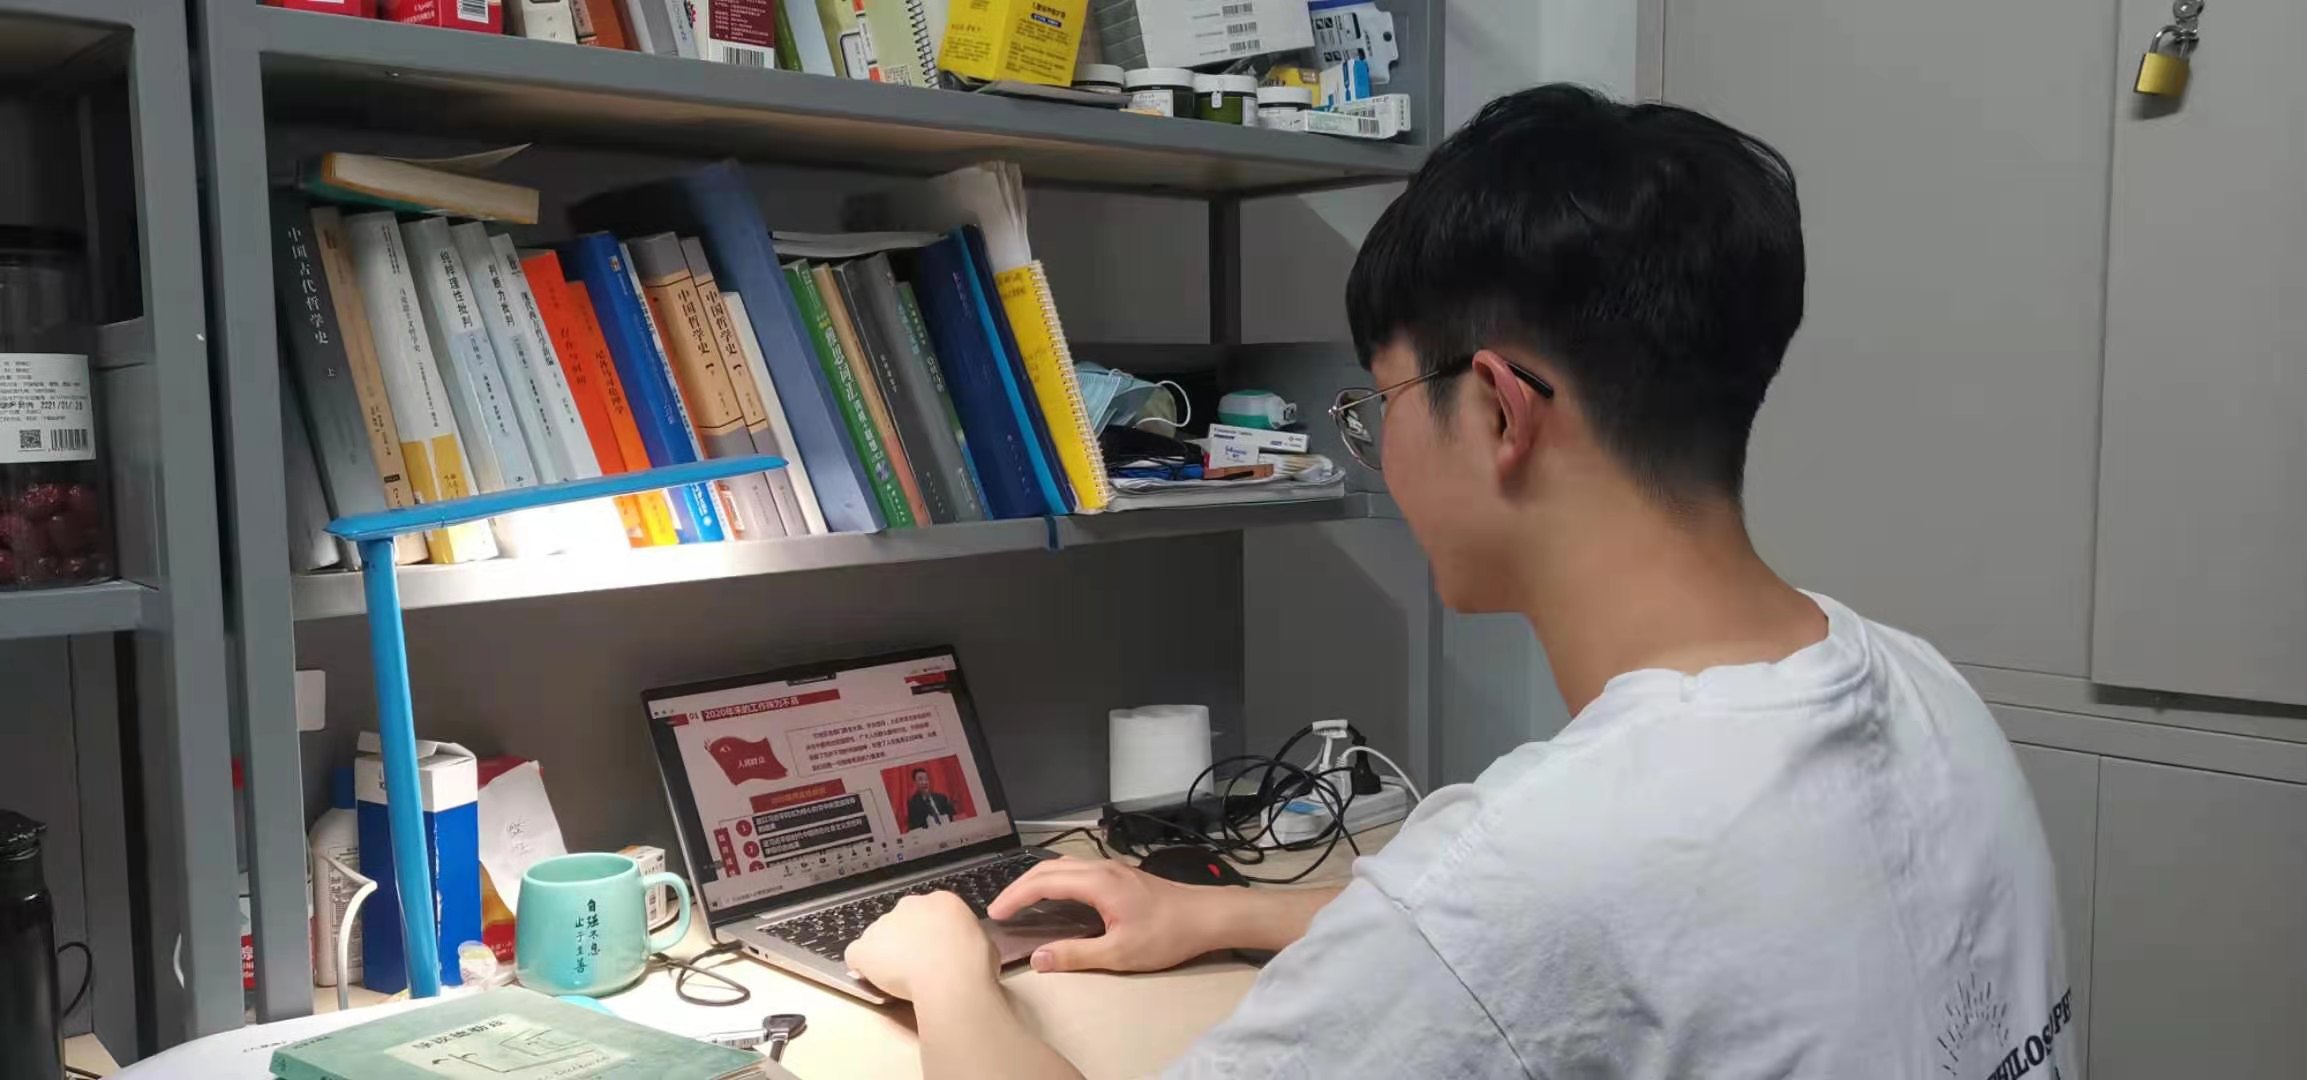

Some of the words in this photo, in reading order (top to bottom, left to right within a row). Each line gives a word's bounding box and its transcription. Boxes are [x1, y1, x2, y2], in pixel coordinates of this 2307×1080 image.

[288, 227, 329, 345] 中国古代哲学史
[440, 248, 473, 329] 纯粹理性批判
[488, 263, 515, 329] 判断力批判
[677, 288, 711, 357] 中国哲学史
[706, 289, 738, 357] 中国哲学史
[326, 367, 337, 378] 上
[573, 913, 588, 974] 止于至善
[586, 898, 601, 957] 自强不息
